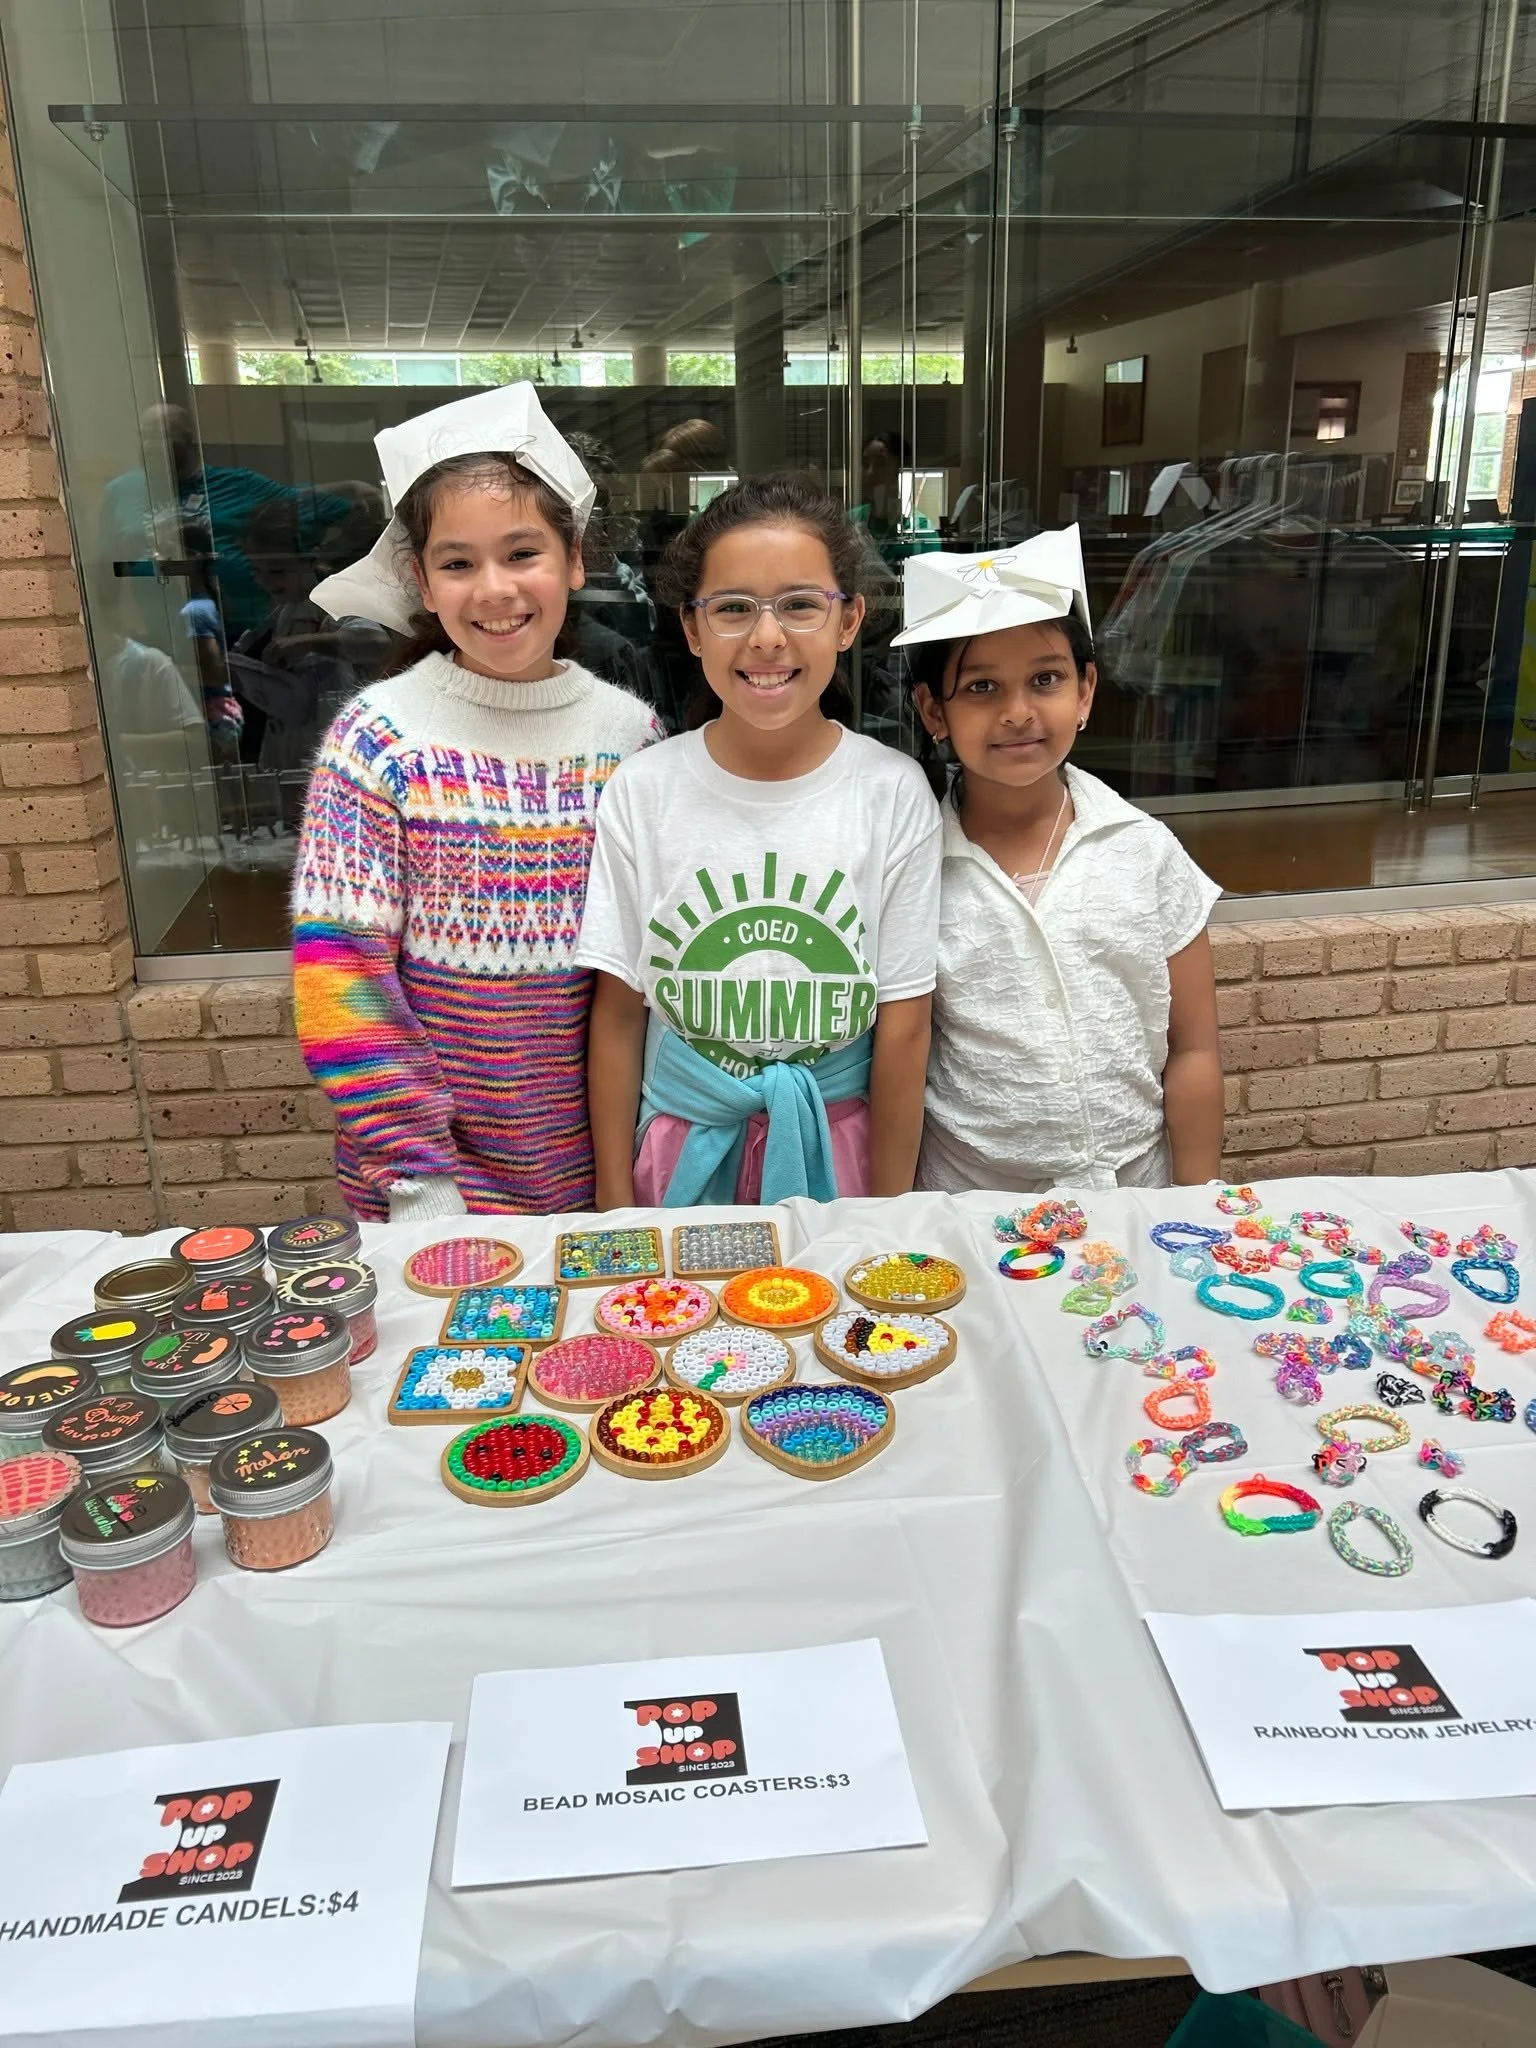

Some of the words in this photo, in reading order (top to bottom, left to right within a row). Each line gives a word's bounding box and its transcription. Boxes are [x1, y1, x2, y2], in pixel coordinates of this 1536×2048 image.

[738, 920, 799, 945] COED
[655, 975, 877, 1044] SUMMER
[1319, 1650, 1401, 1671] POP
[1355, 1672, 1398, 1689] UP
[1339, 1685, 1439, 1707] SHOP
[636, 1699, 718, 1726] POP
[663, 1725, 704, 1743] UP
[1253, 1726, 1358, 1739] RAINBOW
[1364, 1727, 1429, 1740] LOOM
[636, 1739, 737, 1766] SHOP
[678, 1763, 710, 1773] SINCE
[710, 1760, 736, 1770] 2023
[523, 1794, 588, 1811] BEAD
[595, 1787, 686, 1806] MOSAIC
[693, 1773, 851, 1799] COASTERS:$3
[160, 1790, 254, 1827] POP
[179, 1824, 227, 1849] UP
[139, 1841, 254, 1878] SHOP
[178, 1873, 215, 1886] SINCE
[215, 1869, 244, 1882] 2023
[0, 1906, 169, 1941] HANDMADE
[175, 1890, 360, 1927] CANDELS:$4
